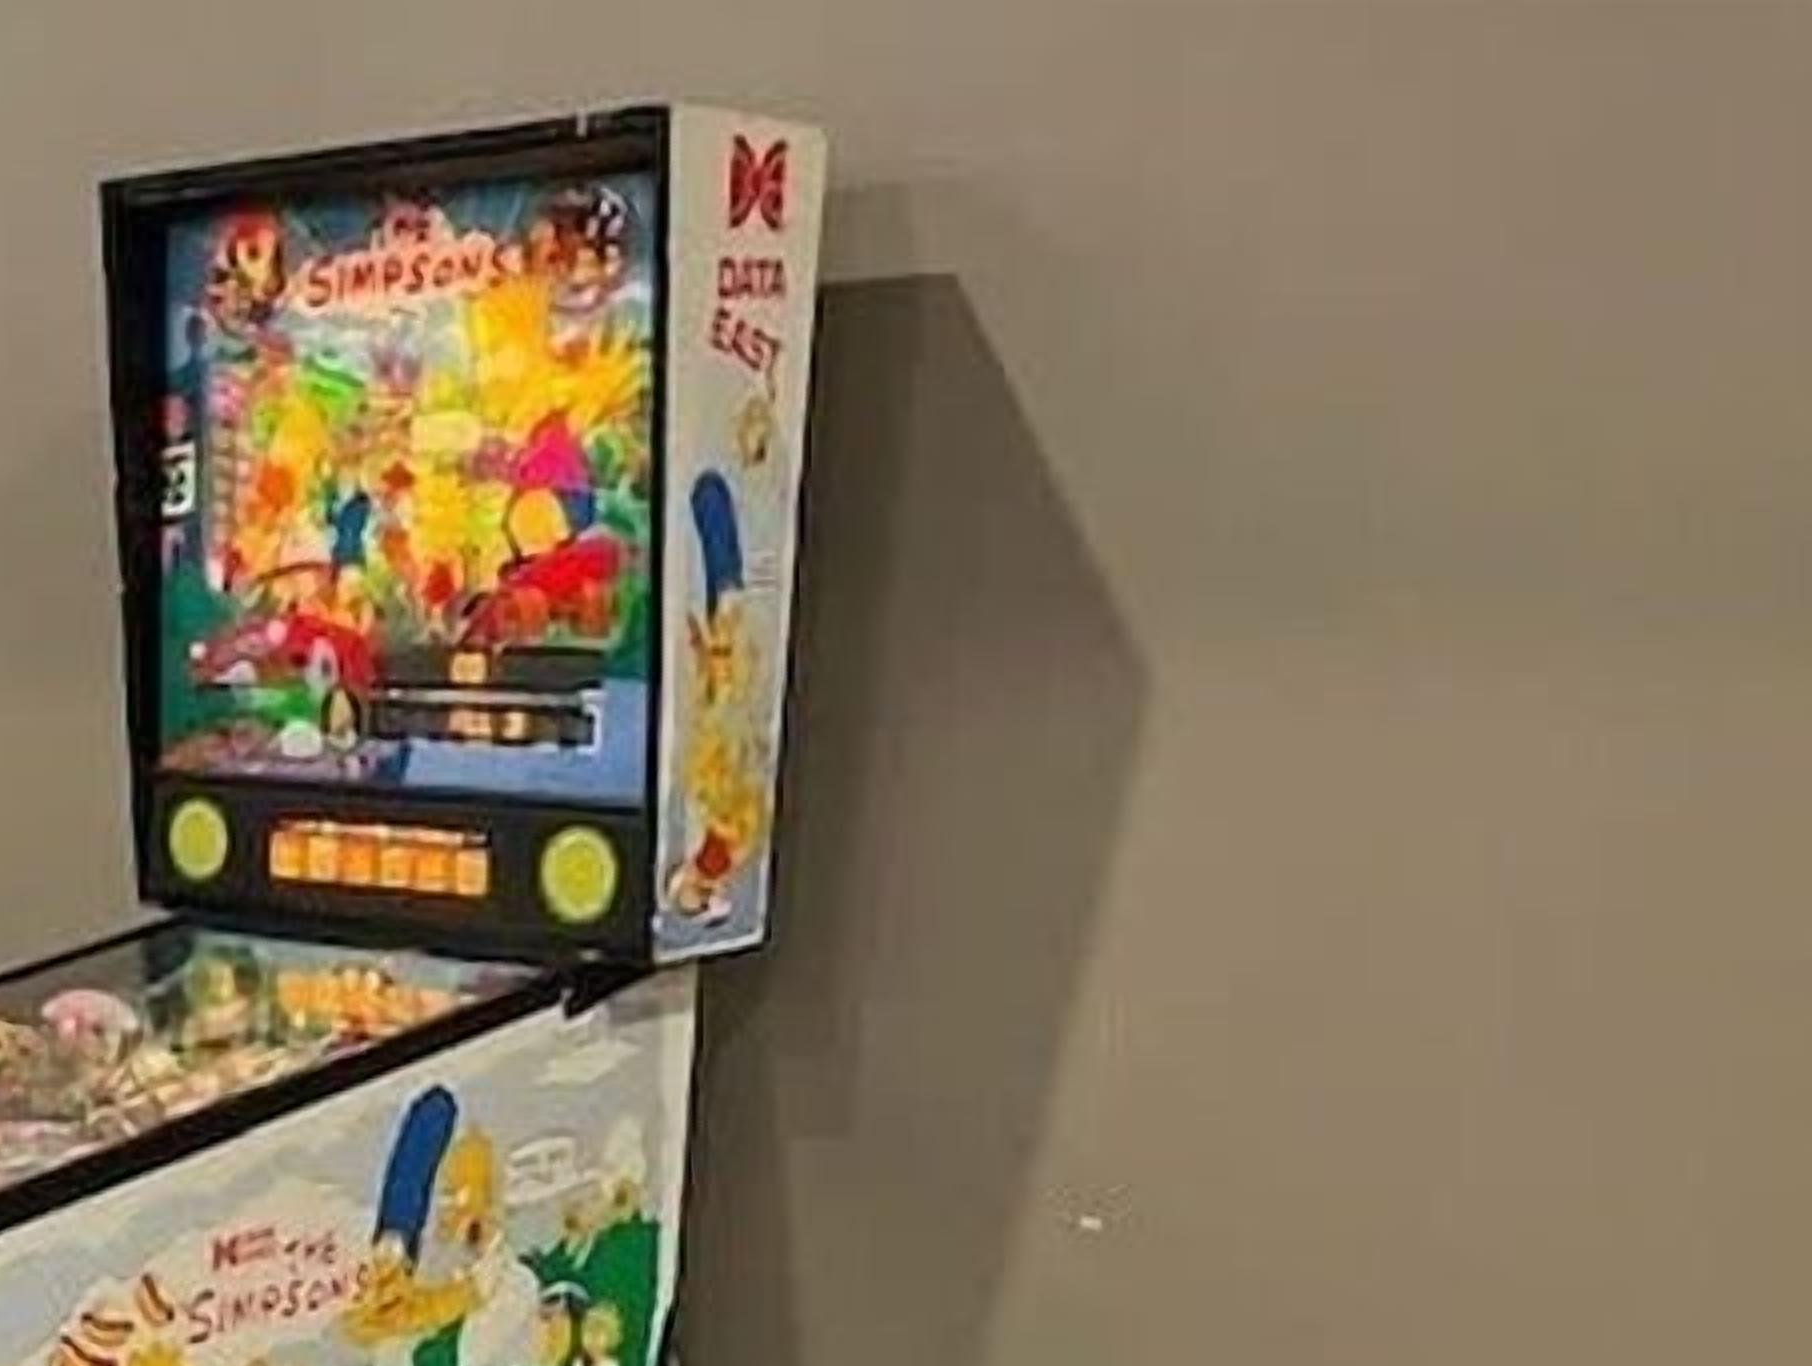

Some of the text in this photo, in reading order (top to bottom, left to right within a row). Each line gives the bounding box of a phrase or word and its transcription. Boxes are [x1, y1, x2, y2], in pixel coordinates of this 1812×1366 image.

[306, 246, 514, 307] SIMPSONS
[718, 258, 784, 298] DATA
[711, 307, 781, 370] EAST
